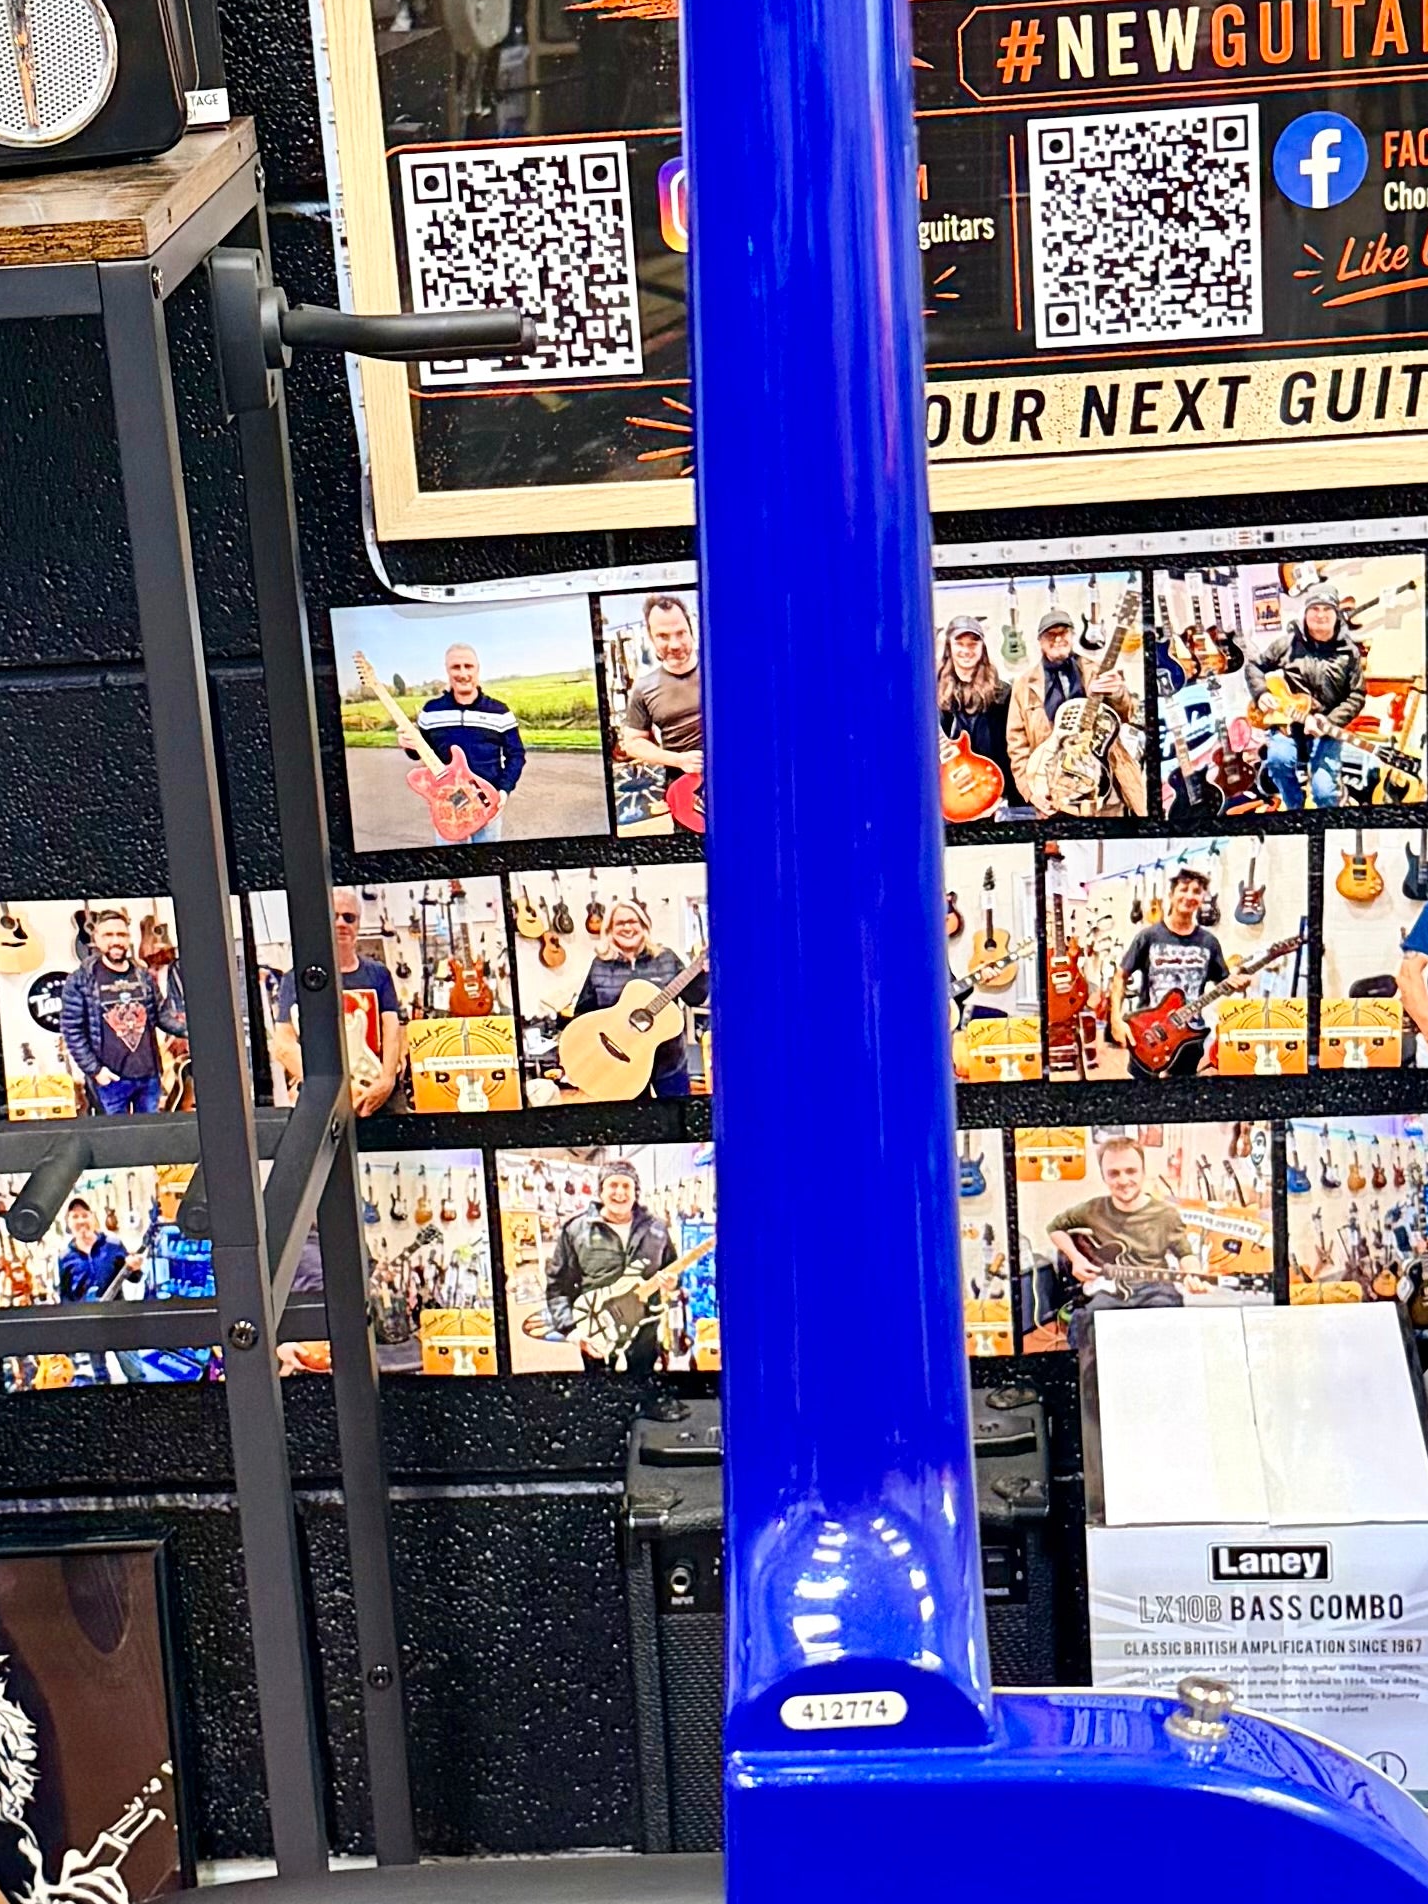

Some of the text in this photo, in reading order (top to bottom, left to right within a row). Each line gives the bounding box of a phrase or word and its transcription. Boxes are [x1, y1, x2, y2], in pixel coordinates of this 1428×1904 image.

[1336, 225, 1411, 283] Like
[925, 389, 1046, 447] OUR
[1079, 374, 1252, 439] NEXT
[1217, 1546, 1322, 1579] Laney
[1139, 1593, 1405, 1624] LX10B BASS COMBO
[1123, 1637, 1424, 1657] CLASSIC BRITISH AMPLIFICATION SINCE 1967
[801, 1698, 889, 1722] 412774
